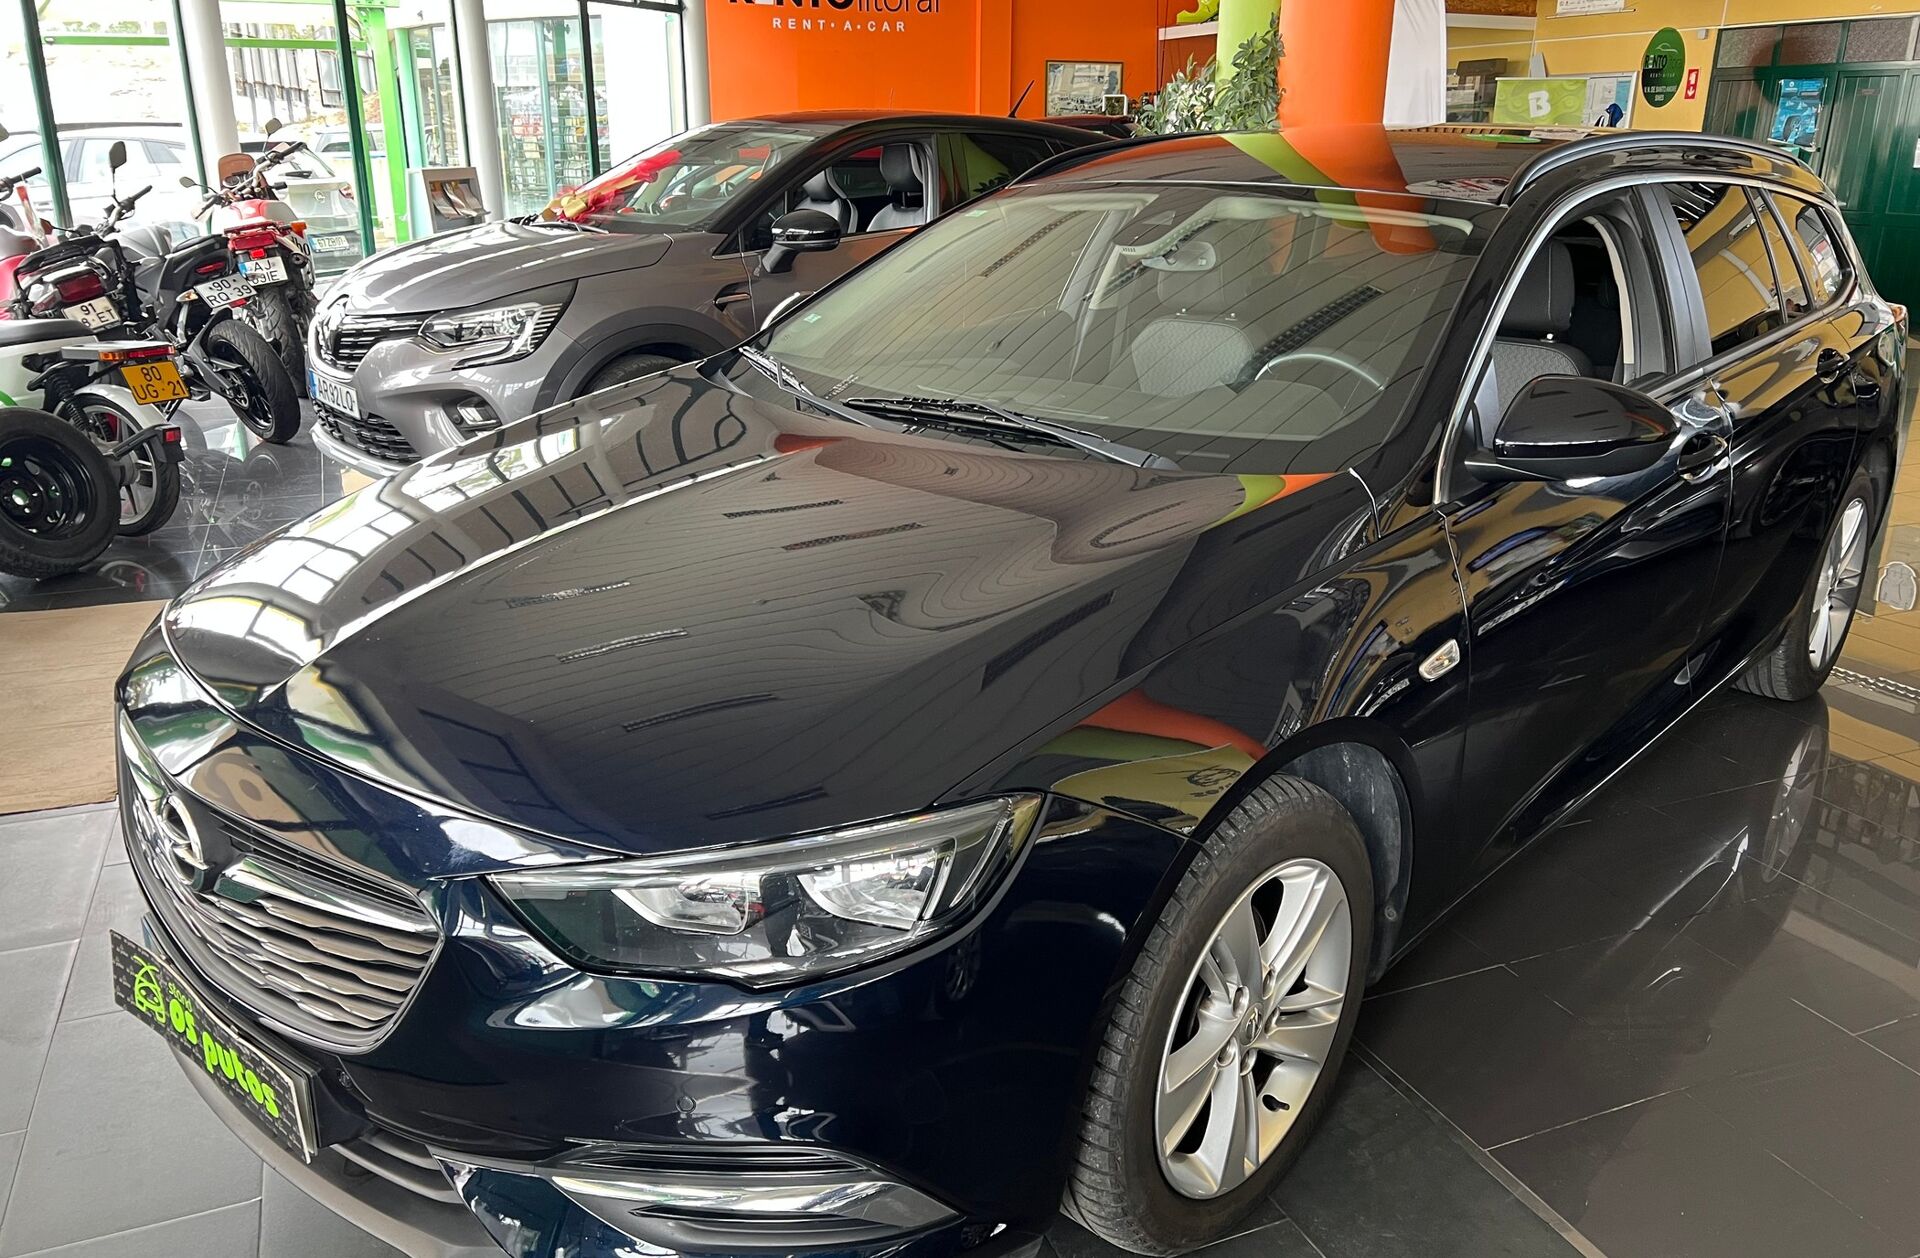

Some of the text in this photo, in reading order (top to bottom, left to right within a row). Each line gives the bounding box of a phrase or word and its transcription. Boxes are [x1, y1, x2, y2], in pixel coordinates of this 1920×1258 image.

[254, 259, 272, 272] AJ
[212, 279, 231, 292] 90
[80, 303, 97, 316] 91
[141, 366, 162, 382] 80
